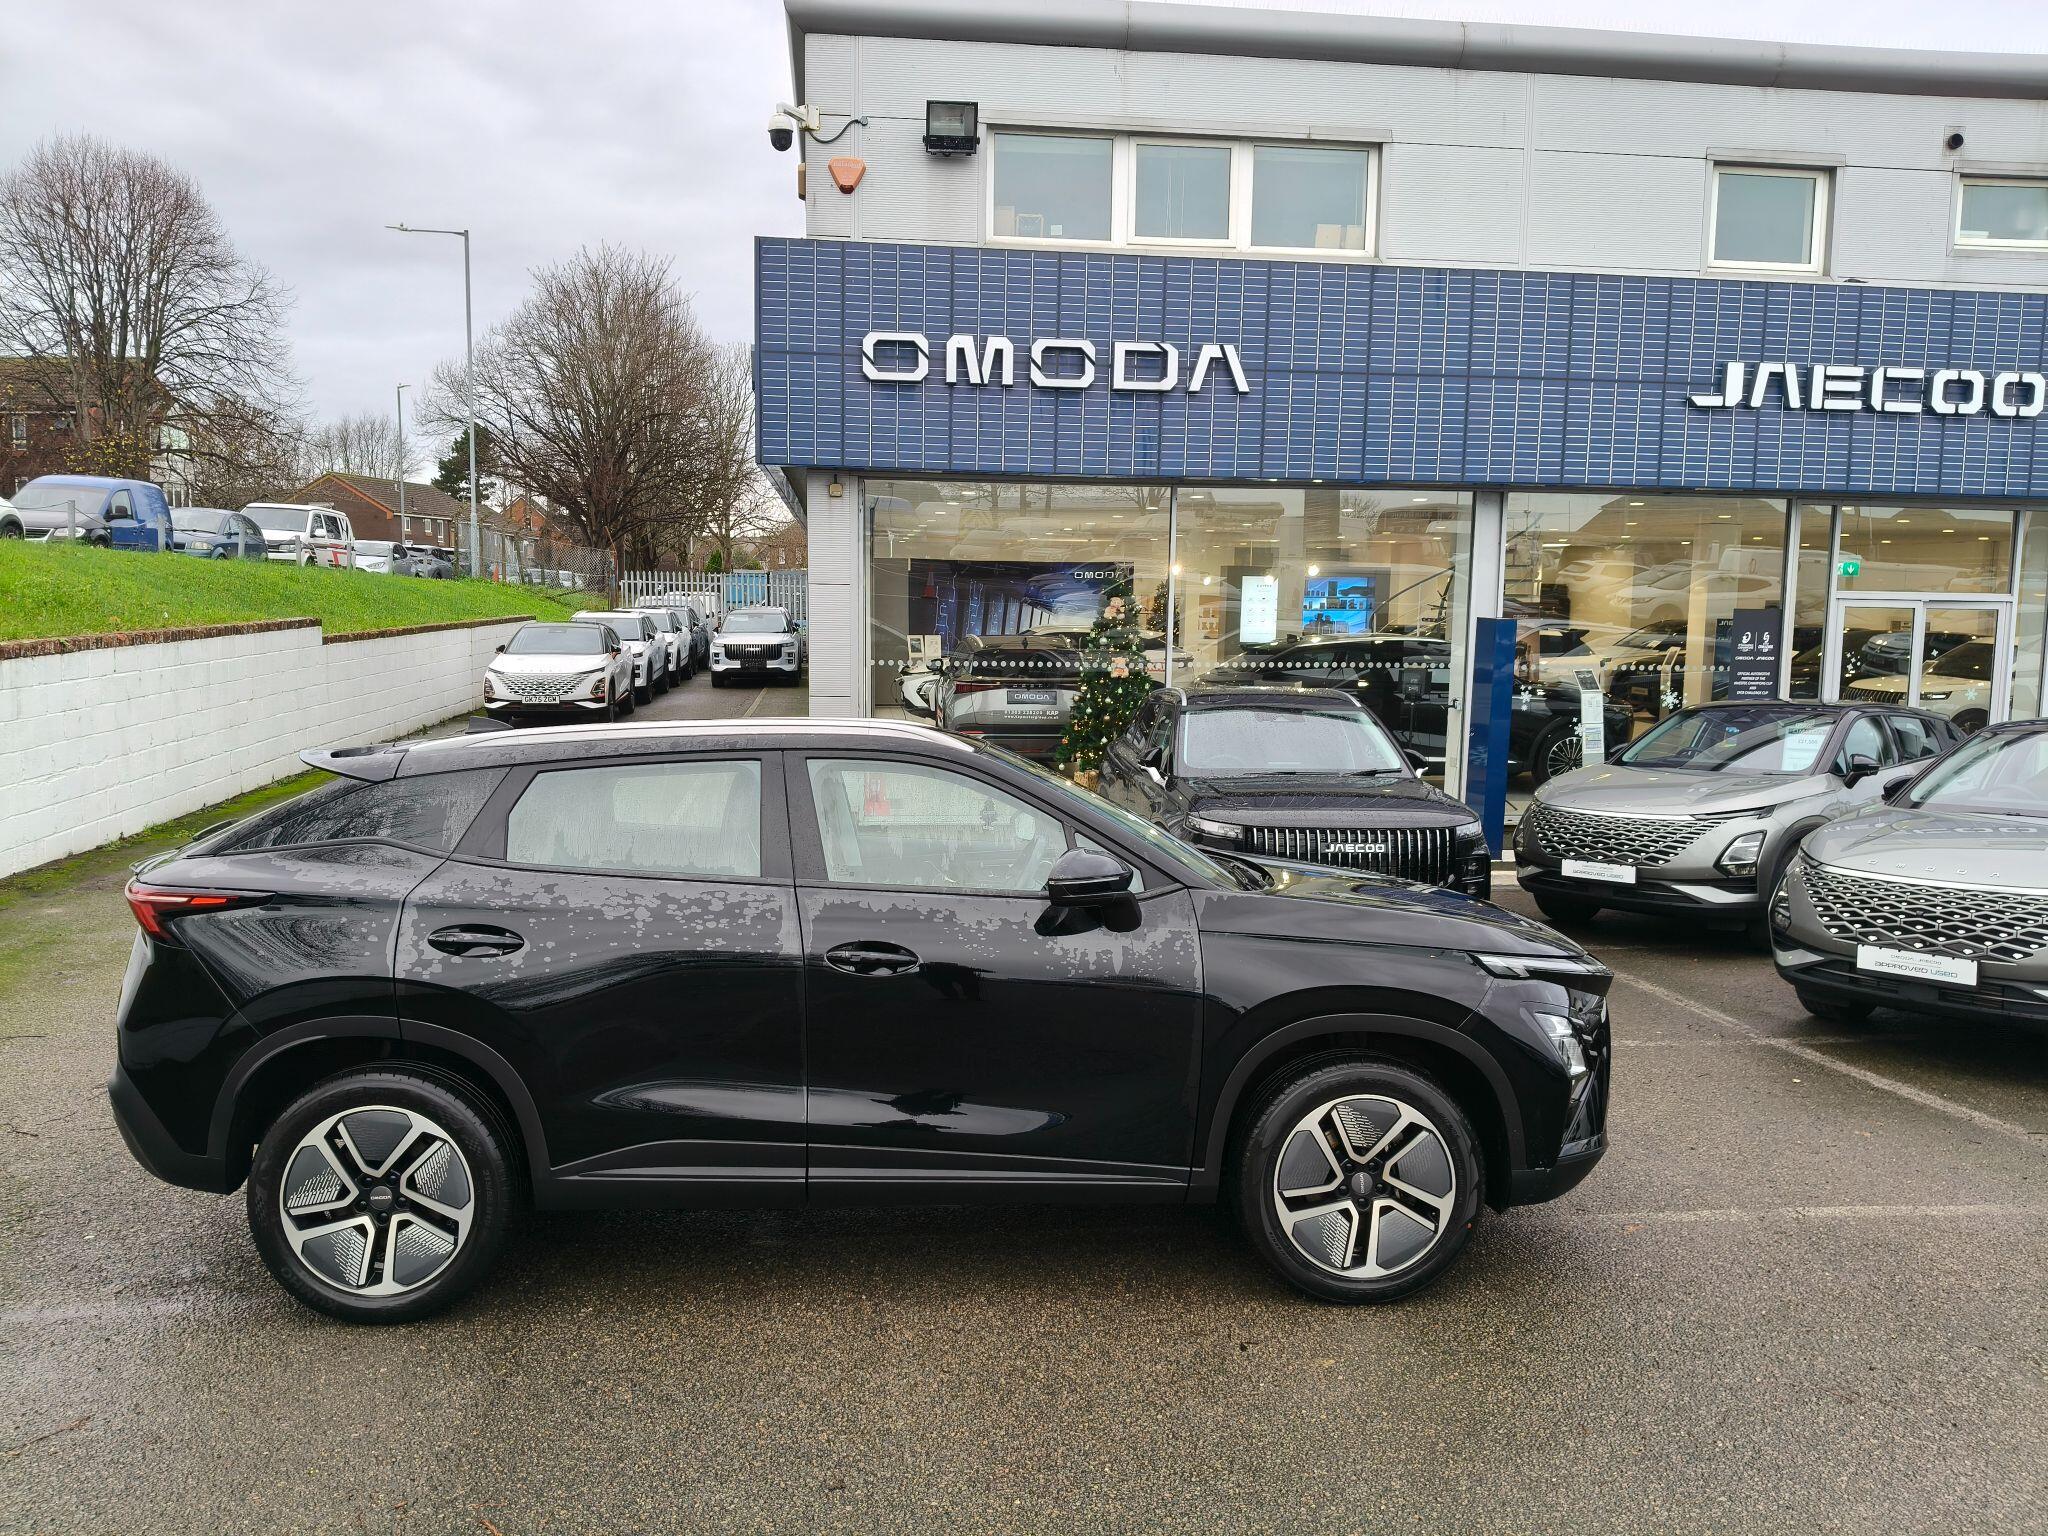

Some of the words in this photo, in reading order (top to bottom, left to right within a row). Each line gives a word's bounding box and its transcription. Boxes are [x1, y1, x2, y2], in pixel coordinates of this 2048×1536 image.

[861, 331, 1251, 394] OMODA
[1688, 361, 2047, 417] JAECOO
[1325, 843, 1385, 853] JAECOO
